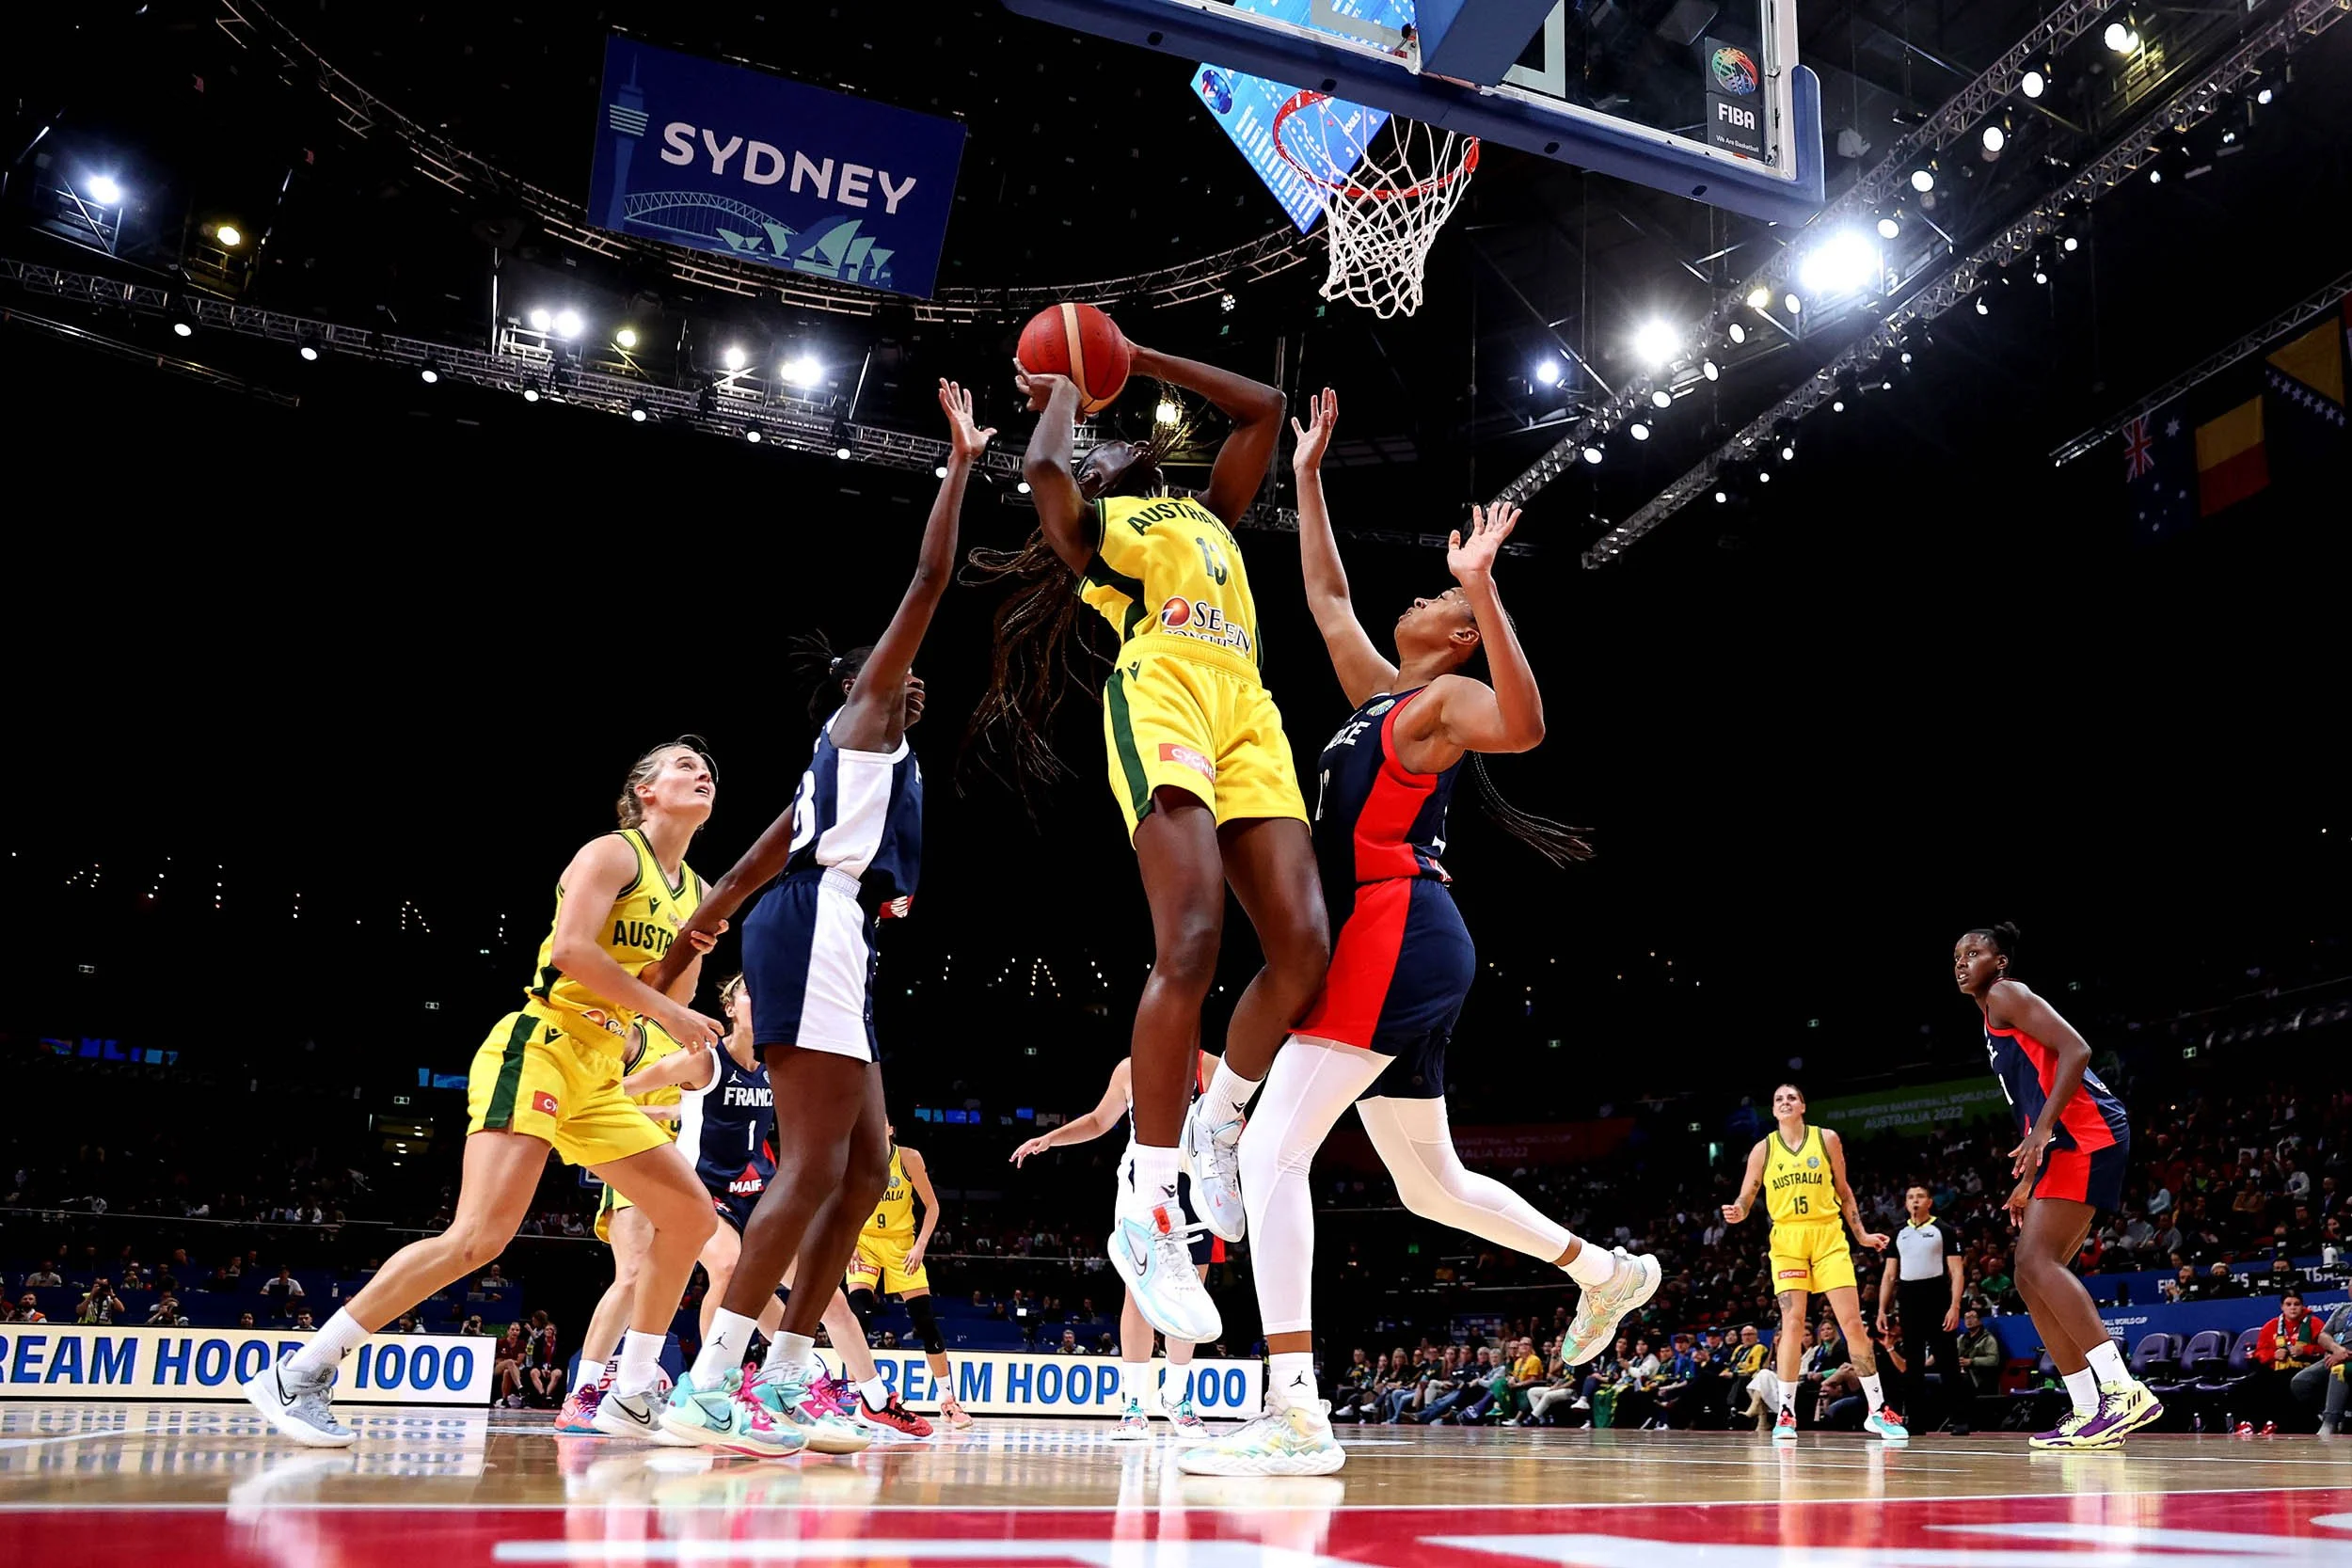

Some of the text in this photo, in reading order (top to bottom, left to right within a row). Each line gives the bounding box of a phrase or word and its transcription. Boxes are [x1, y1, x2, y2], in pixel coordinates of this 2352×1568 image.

[1718, 103, 1756, 131] FIBA
[1715, 135, 1759, 152] We Are Basketball
[660, 121, 917, 214] SYDNEY
[723, 1086, 773, 1107] FRANC
[1864, 1106, 1964, 1130] AUSTRALIA 2022
[748, 1120, 756, 1150] 1
[729, 1179, 762, 1194] MAIF
[1772, 1172, 1822, 1191] AUSTRALIA
[881, 1189, 904, 1202] ALIA
[1793, 1196, 1809, 1215] 15
[877, 1213, 886, 1228] 9
[0, 1335, 138, 1386] EAM
[355, 1343, 474, 1391] 1000
[1006, 1363, 1125, 1404] HOOP
